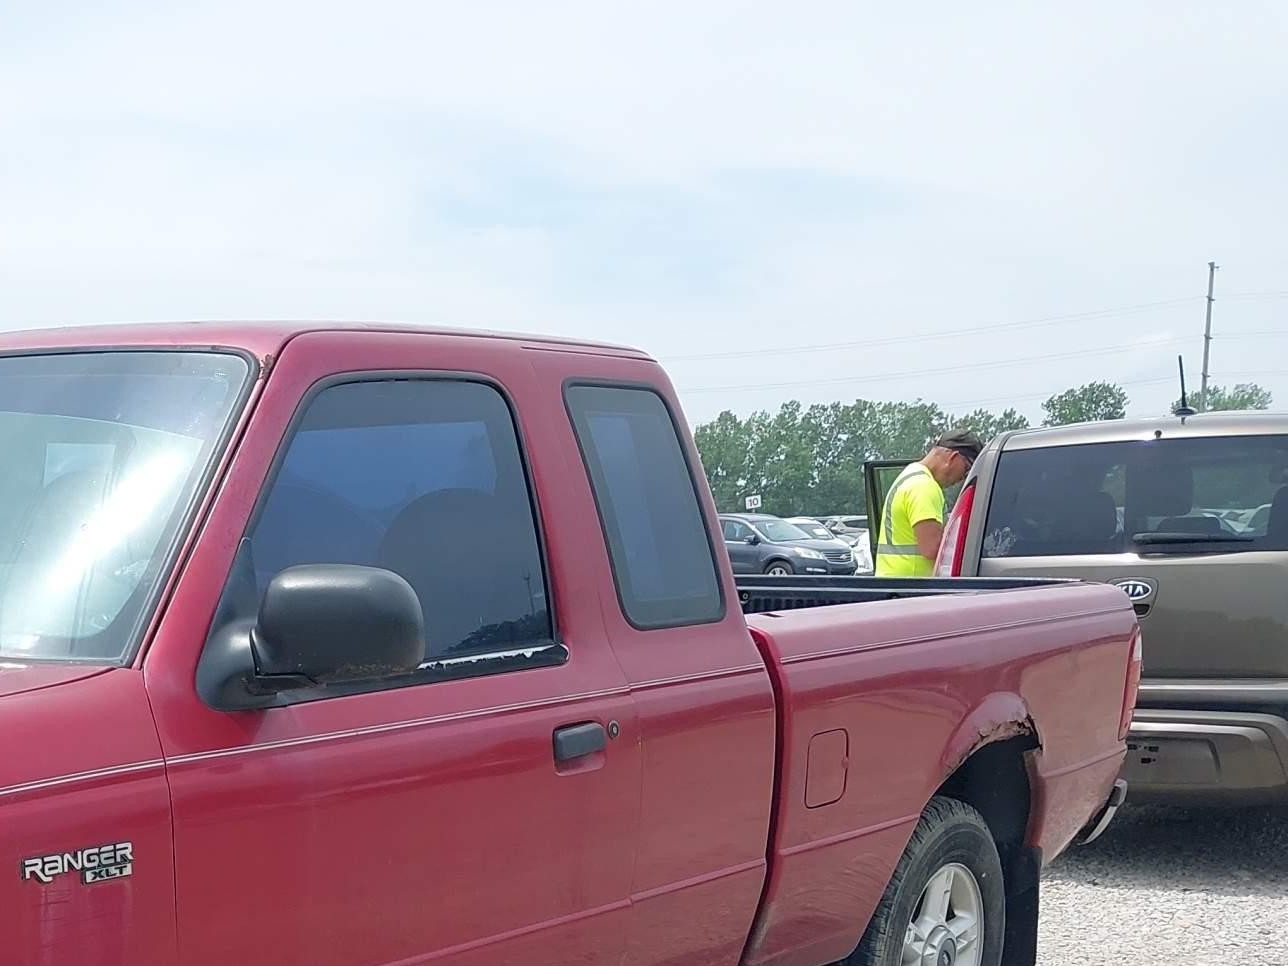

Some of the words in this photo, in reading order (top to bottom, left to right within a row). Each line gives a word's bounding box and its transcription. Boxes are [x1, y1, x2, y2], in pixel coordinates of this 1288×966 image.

[748, 497, 759, 508] 10
[23, 842, 134, 883] RANGER
[89, 865, 129, 882] XLT
